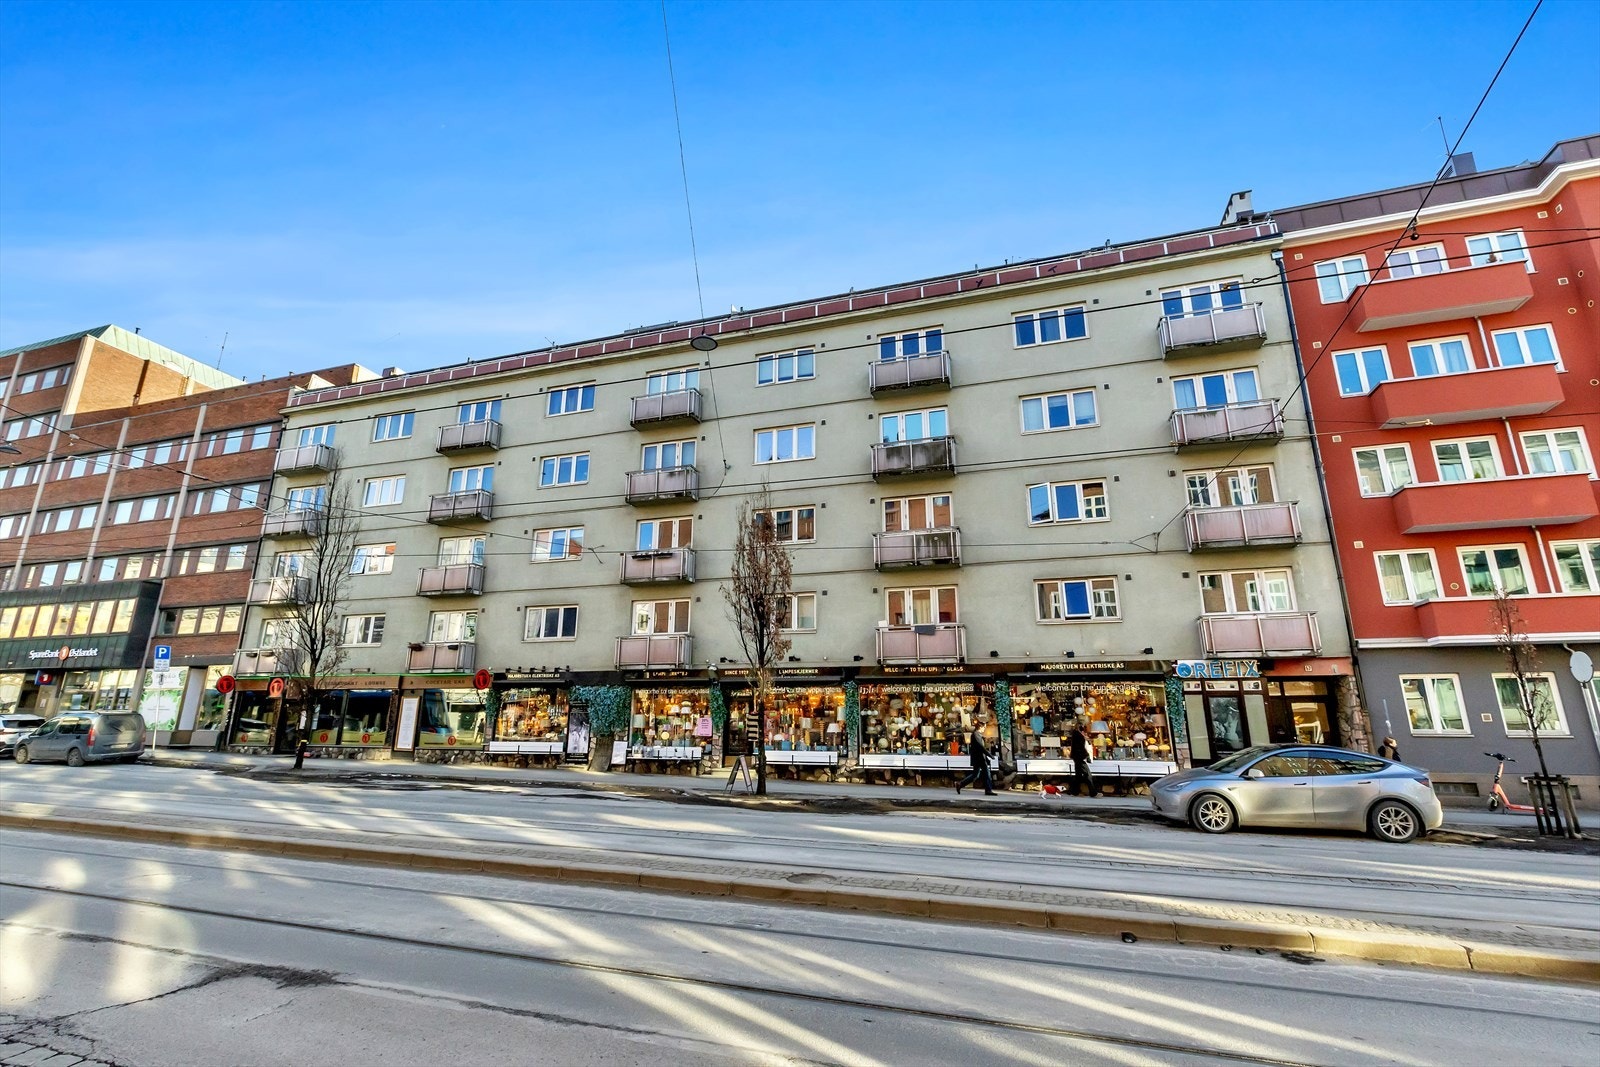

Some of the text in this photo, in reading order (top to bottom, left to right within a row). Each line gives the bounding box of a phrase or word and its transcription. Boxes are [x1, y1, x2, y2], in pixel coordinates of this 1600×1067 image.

[29, 650, 60, 660] SpareBank
[69, 648, 98, 657] Østlandet
[159, 647, 167, 658] P
[882, 685, 911, 693] welcome
[936, 684, 974, 693] upperglass
